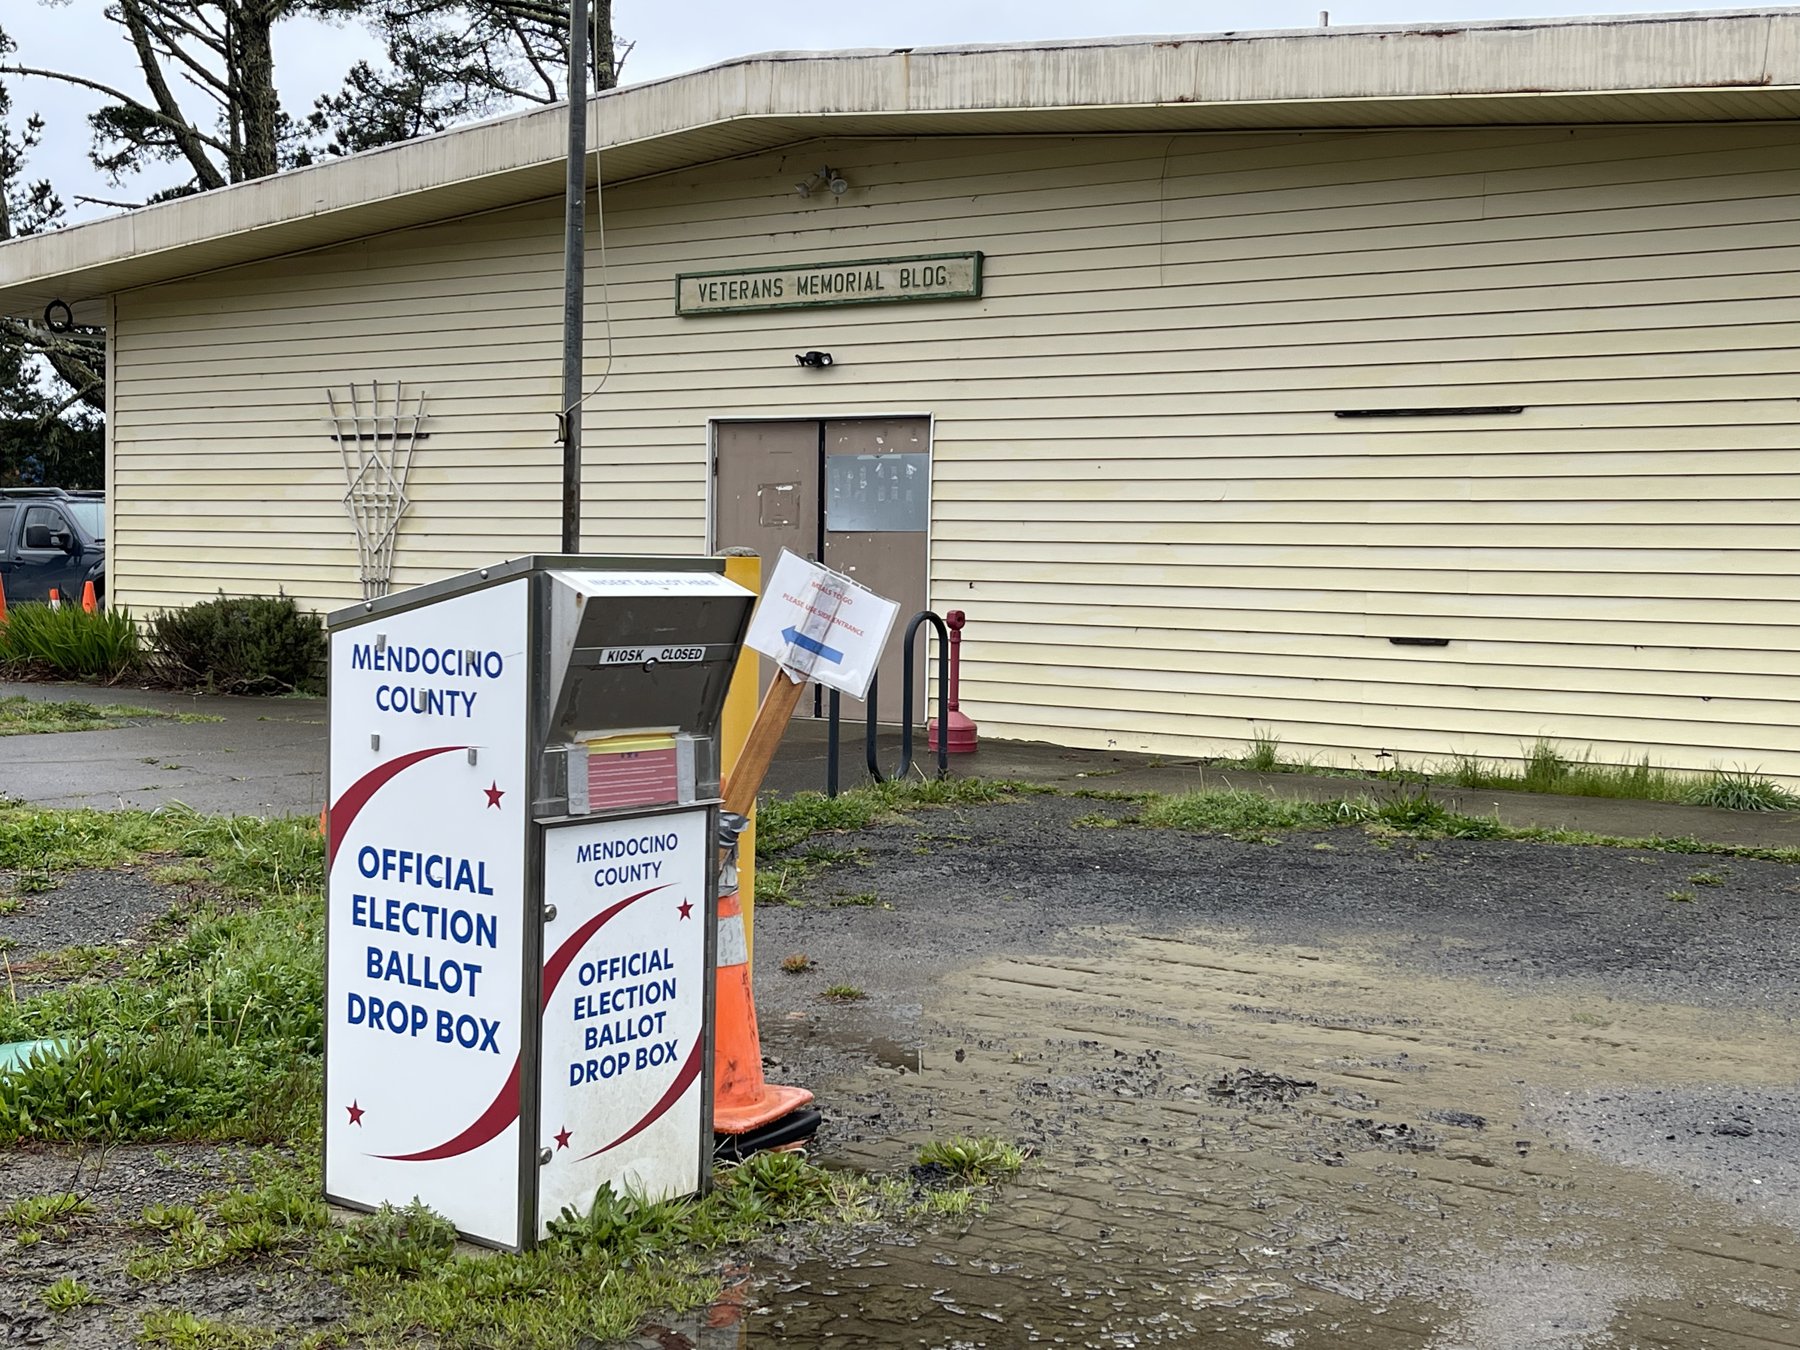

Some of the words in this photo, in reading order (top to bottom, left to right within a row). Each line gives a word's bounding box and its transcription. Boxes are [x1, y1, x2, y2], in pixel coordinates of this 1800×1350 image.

[699, 277, 783, 302] VETERANS
[797, 270, 884, 297] MEMORIAL
[783, 592, 804, 608] PLEASE
[832, 616, 864, 637] ENTRANCE
[842, 595, 854, 606] GO
[352, 644, 504, 680] MENDOCINO
[607, 648, 644, 662] KIOSK
[661, 648, 703, 661] CLOSED
[376, 685, 478, 718] COUNTY
[577, 832, 679, 863] MENDOCINO
[358, 844, 494, 897] OFFICIAL
[594, 860, 663, 888] COUNTY
[352, 894, 497, 949] ELECTION
[366, 945, 482, 998] BALLOT
[578, 947, 674, 987] OFFICIAL
[573, 978, 677, 1021] ELECTION
[347, 991, 429, 1038] DROP
[436, 1009, 500, 1054] BOX
[584, 1010, 667, 1051] BALLOT
[570, 1051, 630, 1087] DROP
[636, 1040, 677, 1071] BOX
